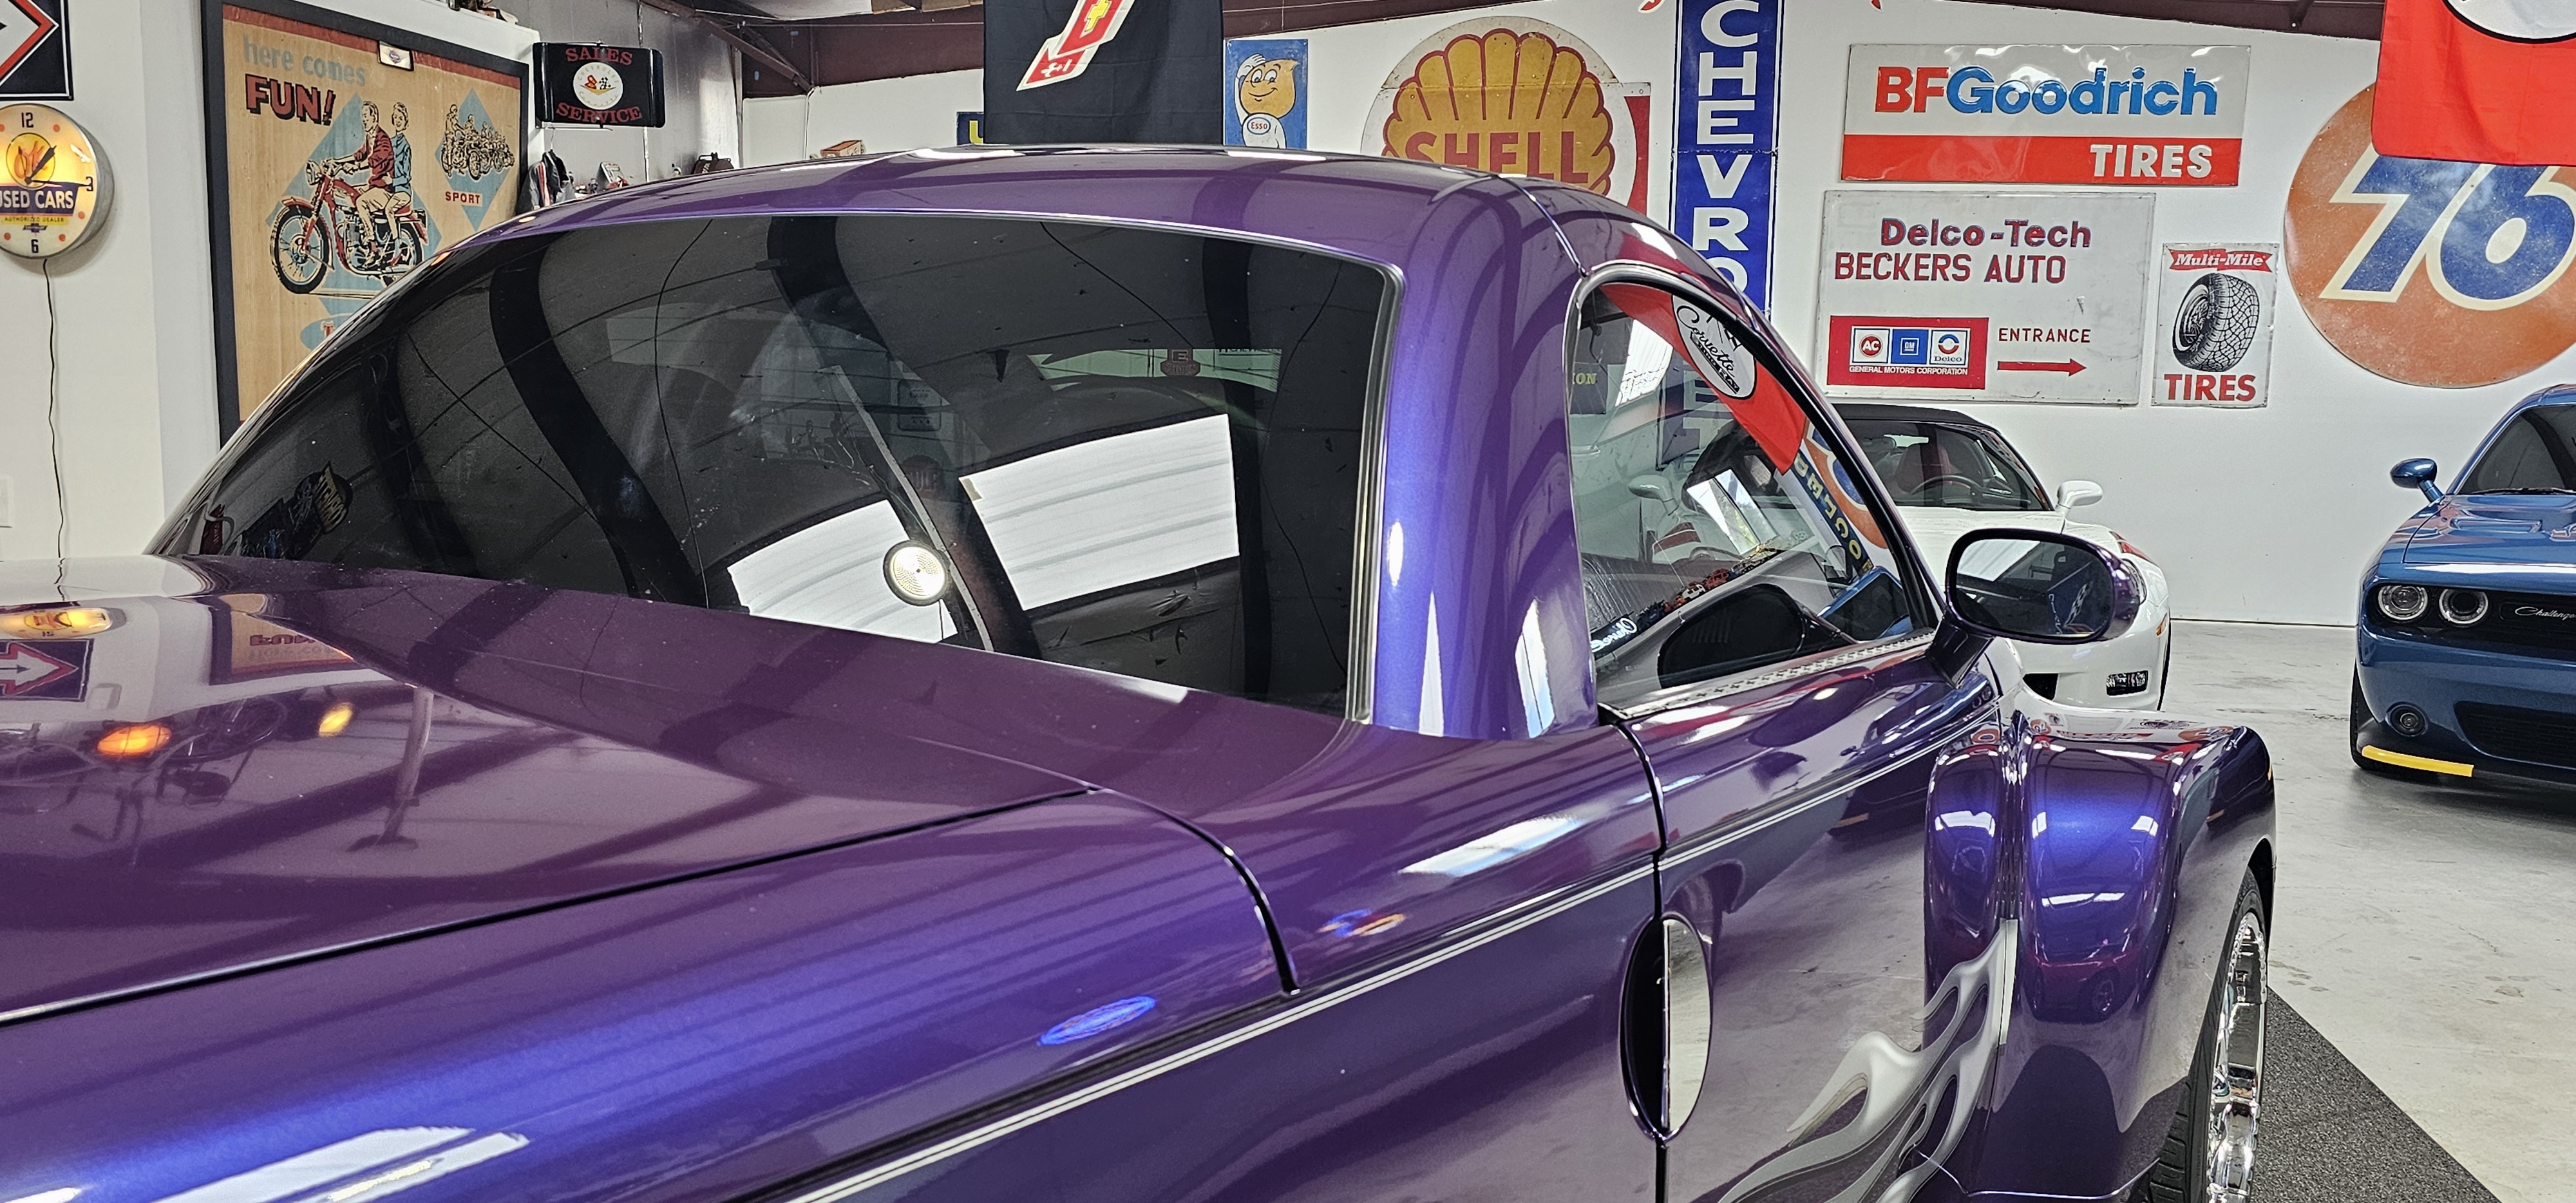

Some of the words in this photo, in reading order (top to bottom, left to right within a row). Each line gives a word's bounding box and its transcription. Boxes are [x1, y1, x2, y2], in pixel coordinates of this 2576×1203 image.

[243, 34, 294, 71] here
[302, 55, 366, 87] comes
[565, 47, 632, 65] SALES
[1875, 66, 2218, 115] BFGoodrich
[245, 73, 336, 126] FUN!
[21, 112, 34, 128] 12
[556, 102, 643, 123] SERVICE
[2090, 144, 2212, 178] TIRES
[0, 190, 30, 208] SED
[35, 191, 74, 209] CARS
[445, 191, 480, 204] SPORT
[31, 239, 39, 254] 6
[1834, 252, 1972, 282] BECKERS
[1984, 254, 2067, 284] AUTO
[2174, 253, 2265, 267] Multi-Mile
[1998, 327, 2092, 343] ENTRANCE
[1862, 340, 1880, 352] AC
[1904, 342, 1915, 350] GM
[1849, 365, 1883, 374] GENERAL
[1917, 367, 1968, 375] CORPORATION
[2164, 374, 2257, 402] TIRES
[2514, 606, 2576, 621] Challenge
